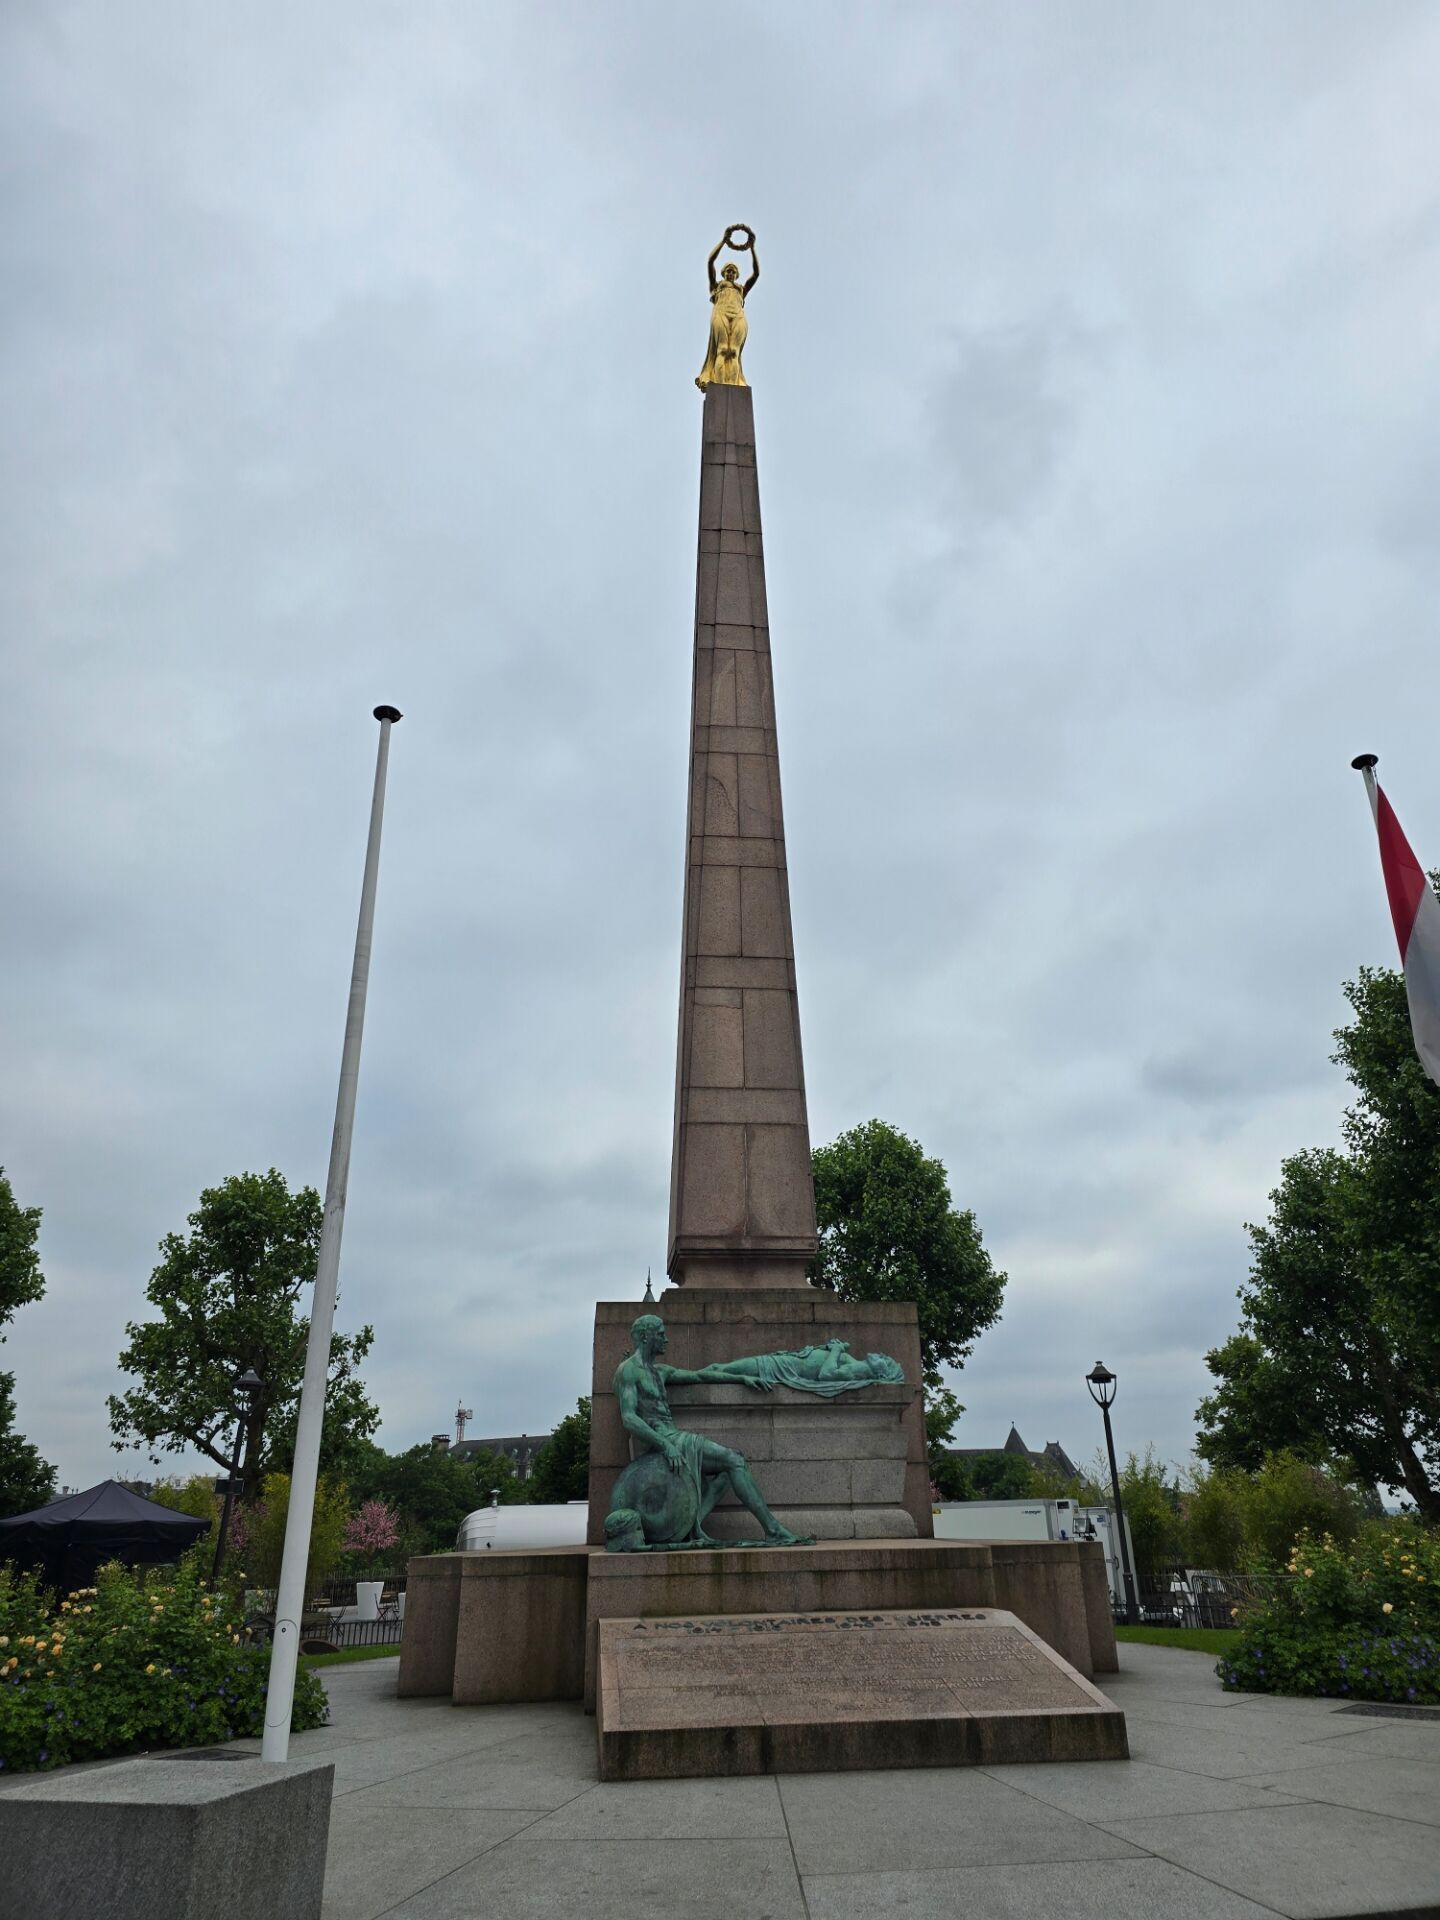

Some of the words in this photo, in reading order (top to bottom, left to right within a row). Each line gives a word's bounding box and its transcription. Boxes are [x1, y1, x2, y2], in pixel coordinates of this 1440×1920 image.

[655, 1621, 694, 1630] NOS
[702, 1617, 836, 1628] VOLONTAIRES
[845, 1615, 883, 1623] DES
